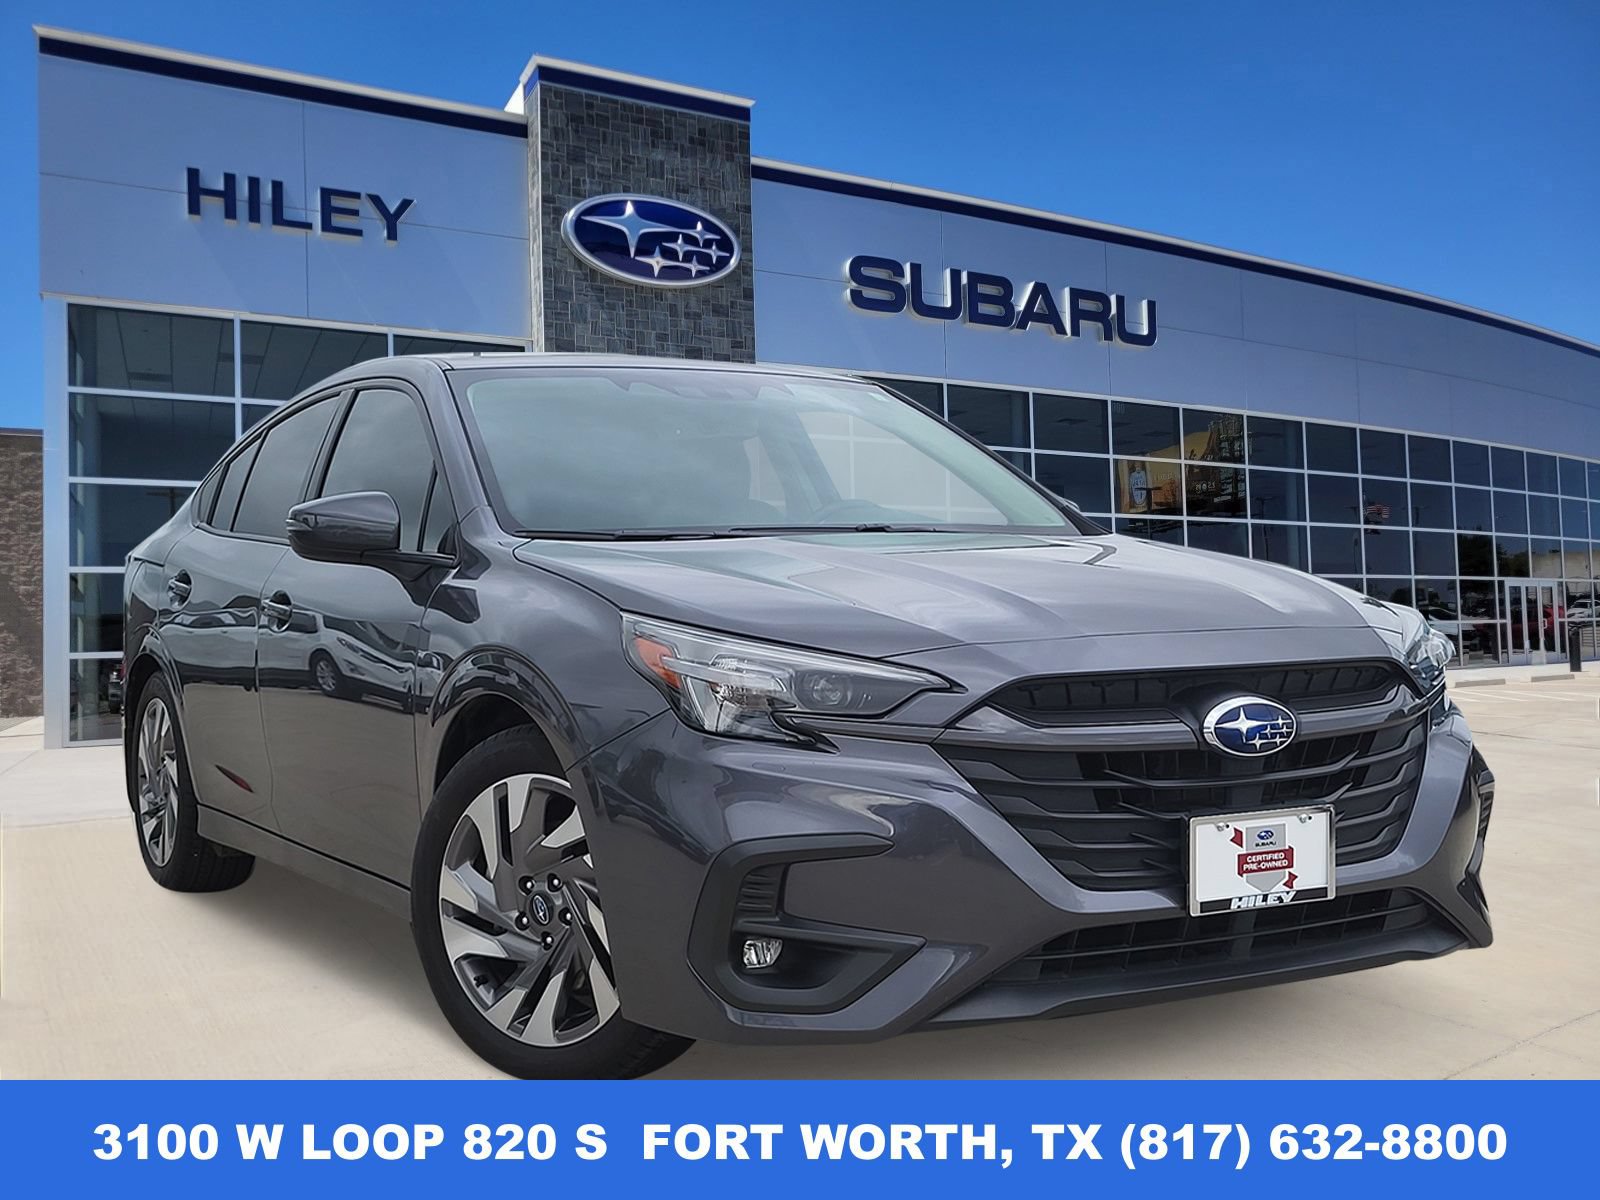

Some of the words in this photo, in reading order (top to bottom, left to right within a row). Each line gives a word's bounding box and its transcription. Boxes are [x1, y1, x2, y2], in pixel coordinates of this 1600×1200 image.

[186, 166, 416, 245] HILEY
[847, 254, 1158, 347] SUBARU
[1243, 860, 1288, 871] PRE-OWNED
[1246, 852, 1285, 863] CERTIFIED
[1230, 891, 1296, 909] HILEY
